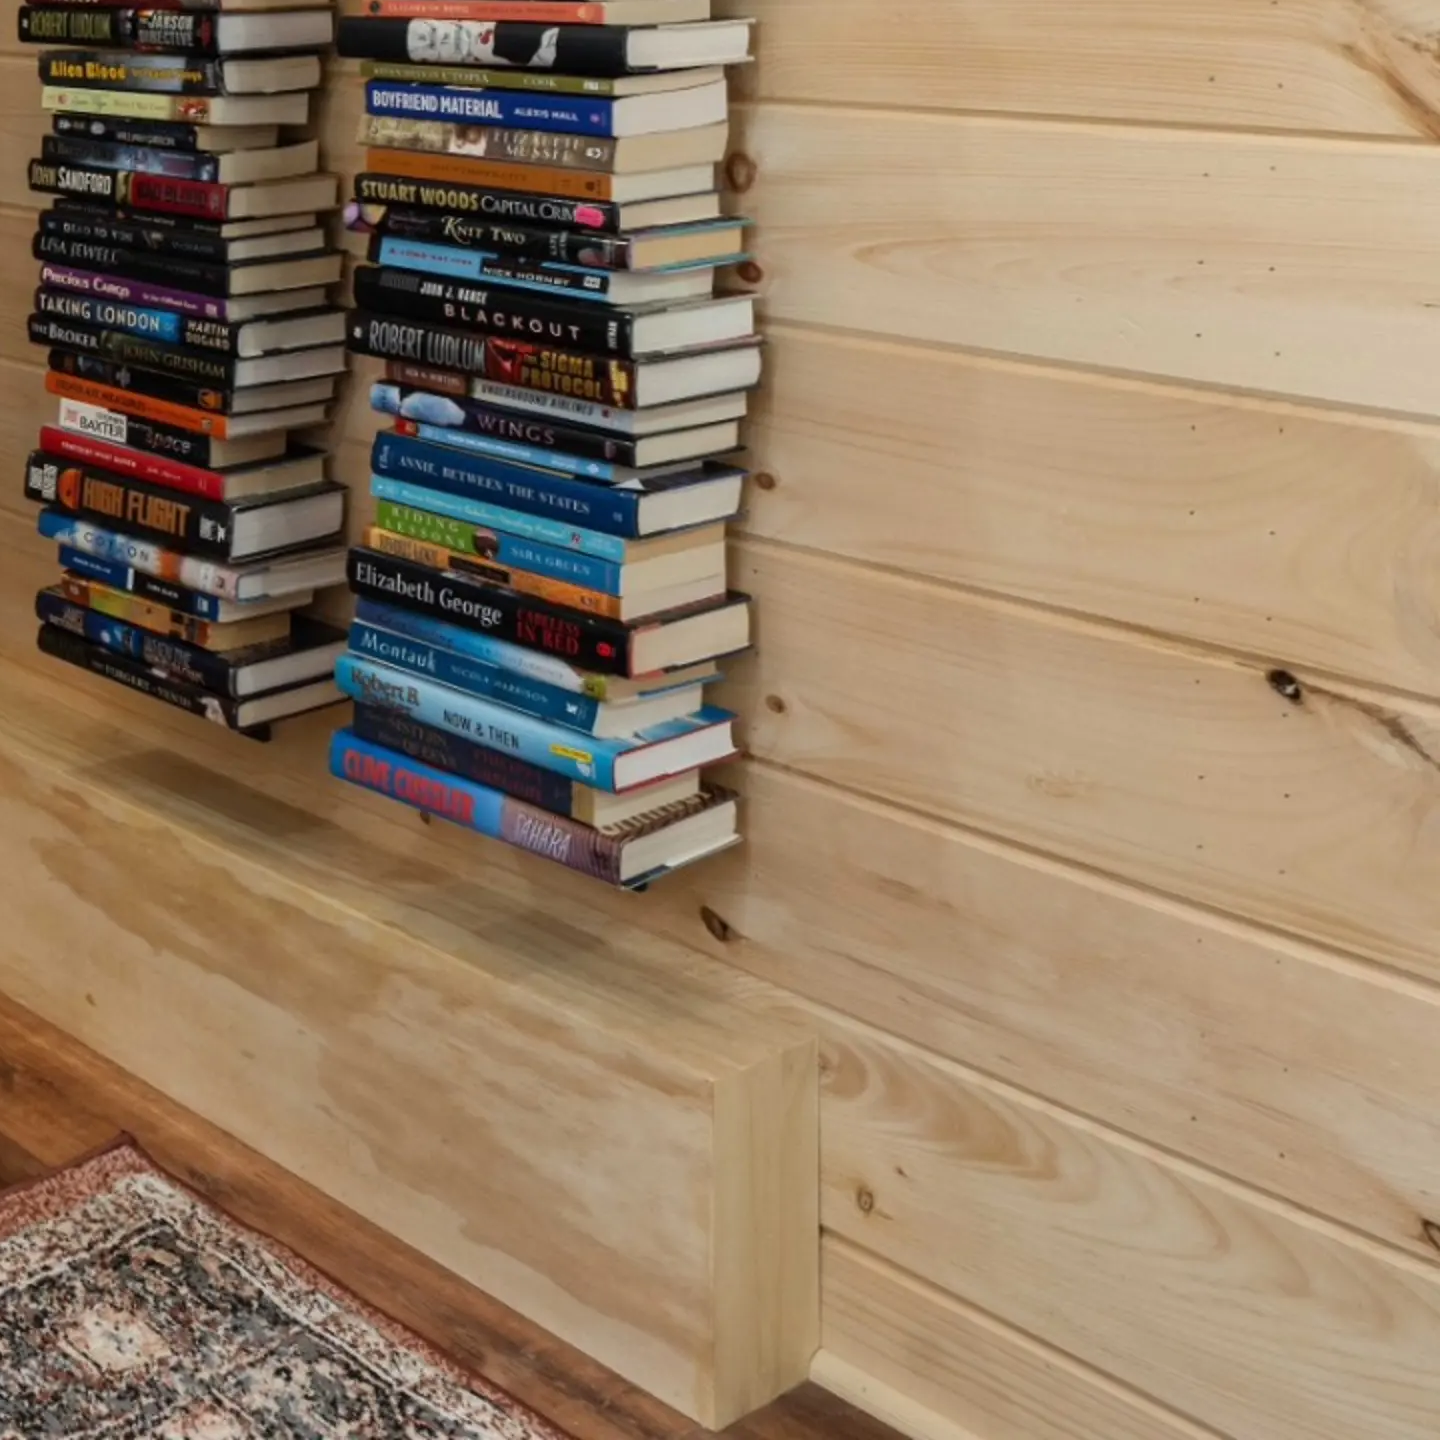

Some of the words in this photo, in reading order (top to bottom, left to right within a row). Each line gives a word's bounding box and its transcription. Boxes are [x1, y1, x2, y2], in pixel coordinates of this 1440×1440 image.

[372, 89, 437, 111] BOYFRIEND
[439, 94, 503, 119] MATERIAL
[513, 106, 548, 119] ALEXIS
[361, 178, 416, 203] STUART
[420, 185, 478, 211] WOODS
[39, 292, 91, 321] TAKING
[96, 304, 160, 334] LONDON
[444, 302, 581, 341] BLACKOUT
[48, 324, 99, 349] BROKER
[369, 319, 424, 360] ROBERT
[427, 329, 486, 373] LUDLUM
[162, 352, 225, 380] GRISHAM
[539, 349, 594, 379] SIGMA
[521, 365, 602, 400] PROTOCOL
[476, 411, 555, 447] WINGS
[127, 487, 190, 542] FLIGHT
[355, 560, 434, 606] Elizabeth
[438, 586, 502, 633] George
[359, 628, 436, 674] Montauk
[443, 707, 472, 733] NOW
[488, 724, 519, 751] THEN
